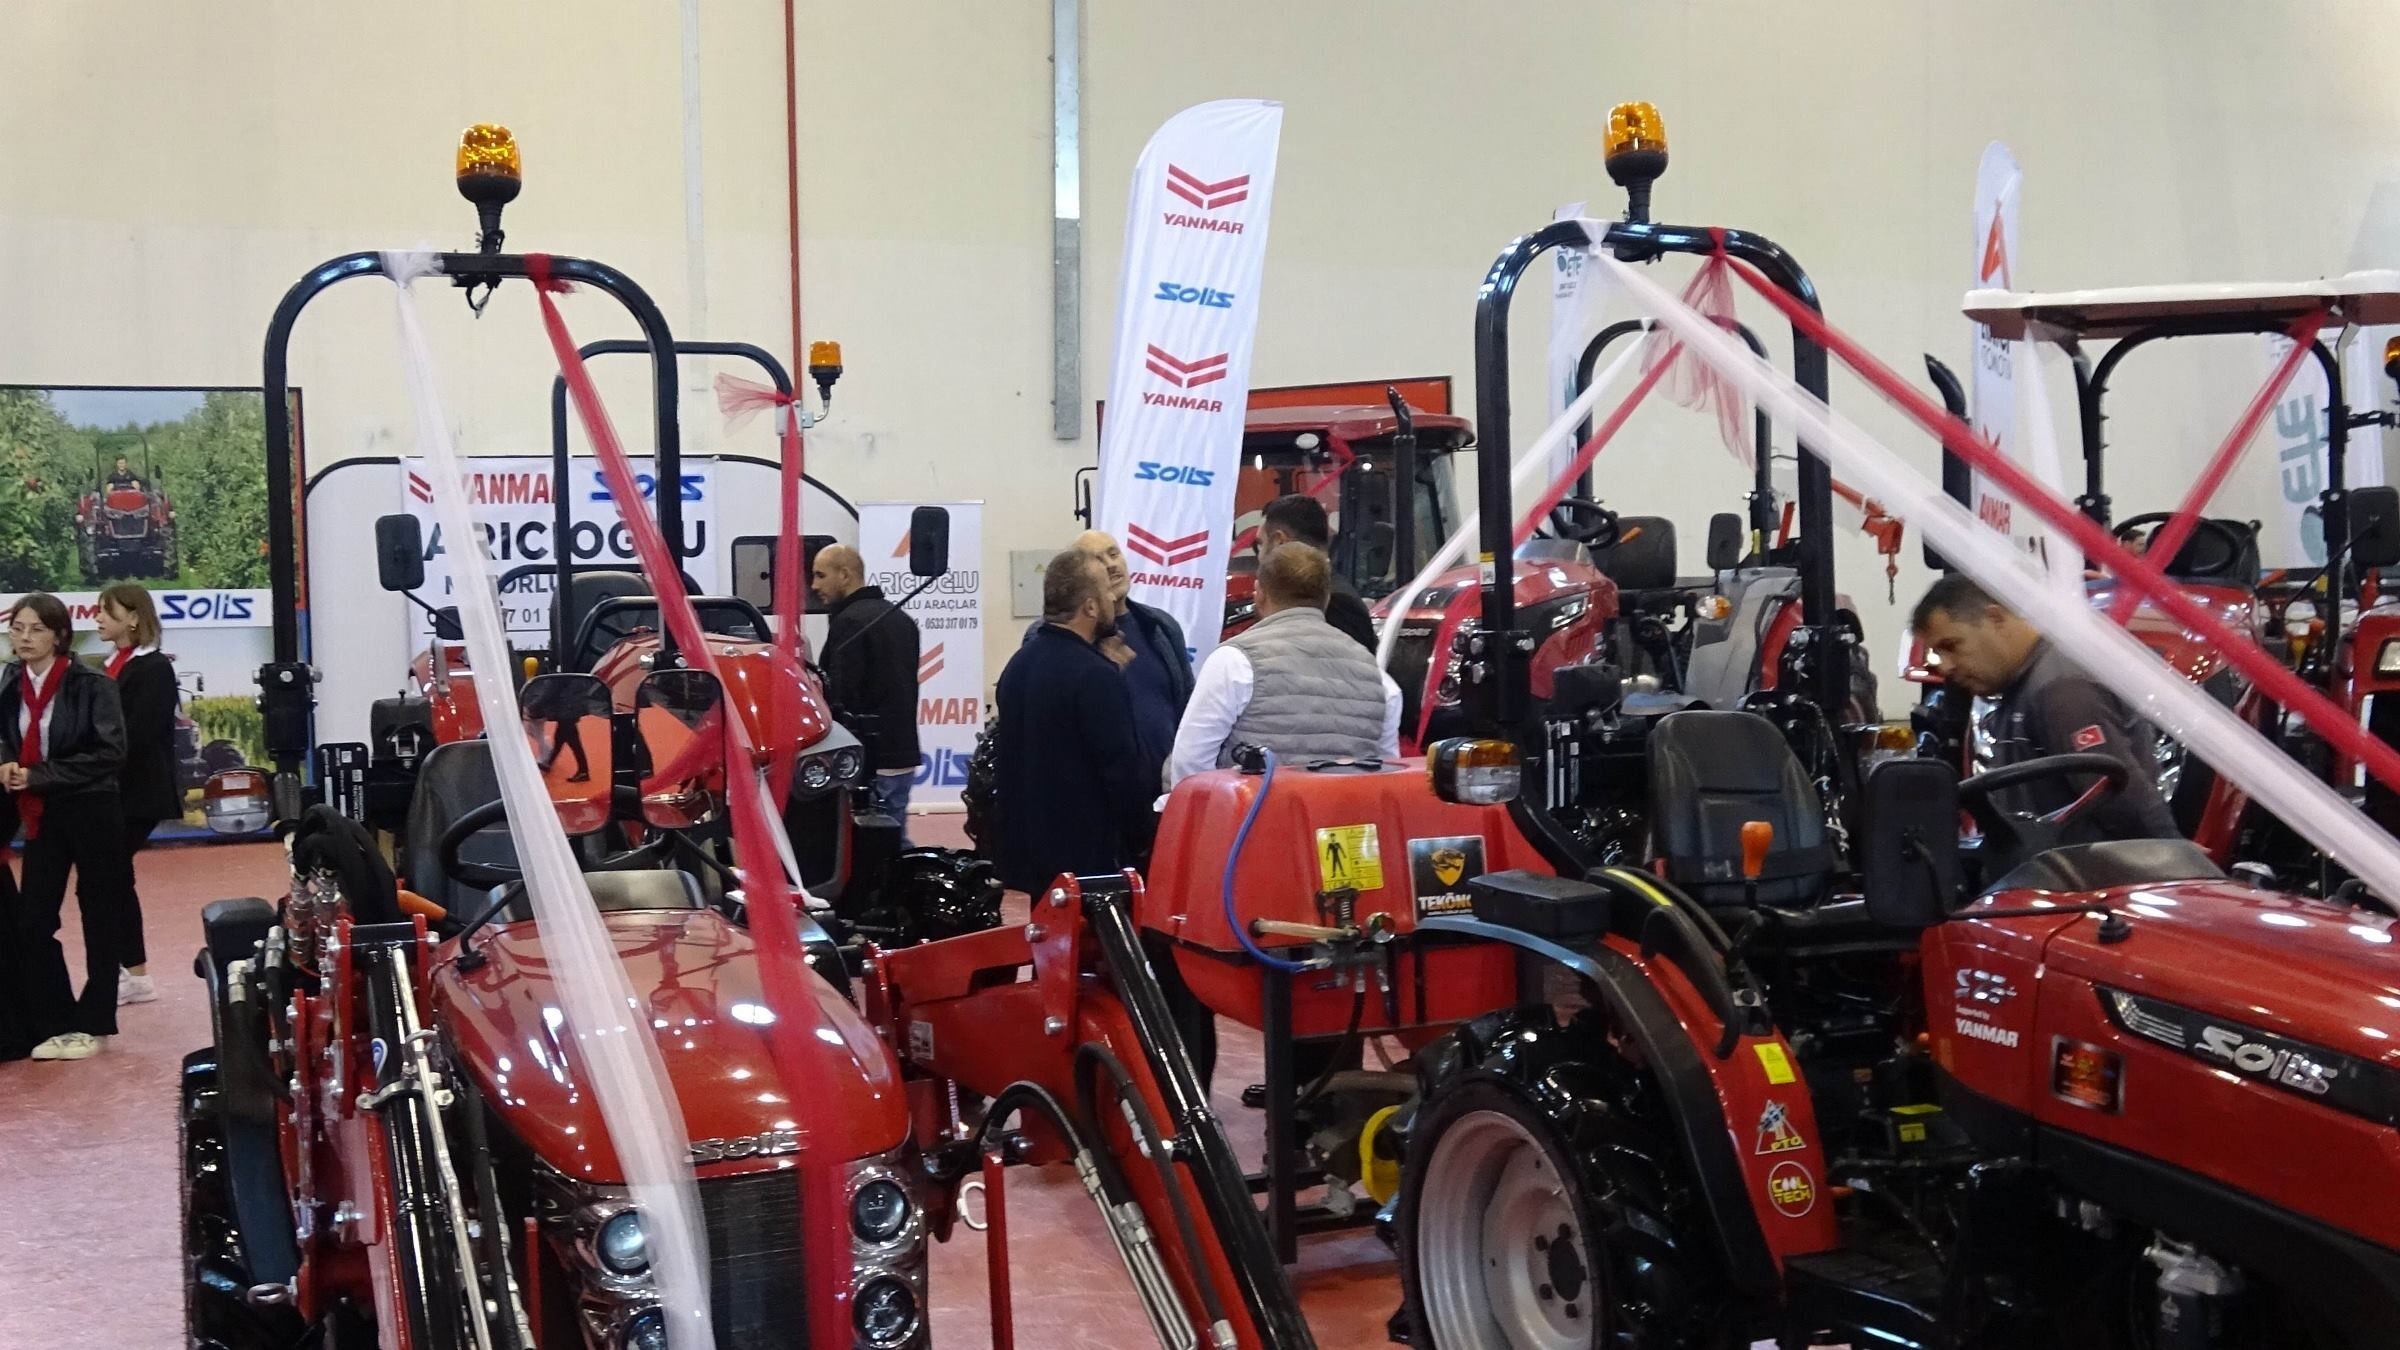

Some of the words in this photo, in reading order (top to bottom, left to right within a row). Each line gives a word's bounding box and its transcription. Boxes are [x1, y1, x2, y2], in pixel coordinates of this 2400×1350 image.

[1163, 212, 1244, 235] YANMAR
[1154, 281, 1235, 308] Solis
[1142, 392, 1223, 413] YANMAR
[1134, 461, 1215, 487] Solis
[462, 472, 558, 505] YANMA
[160, 593, 253, 620] Solis
[522, 608, 541, 623] 01
[924, 599, 977, 611] ARAÇLAR
[919, 697, 978, 725] MAR
[914, 748, 973, 786] olis
[1955, 1017, 2019, 1049] YANMAR
[1771, 1135, 1803, 1152] PTO
[1774, 1189, 1812, 1204] TECH
